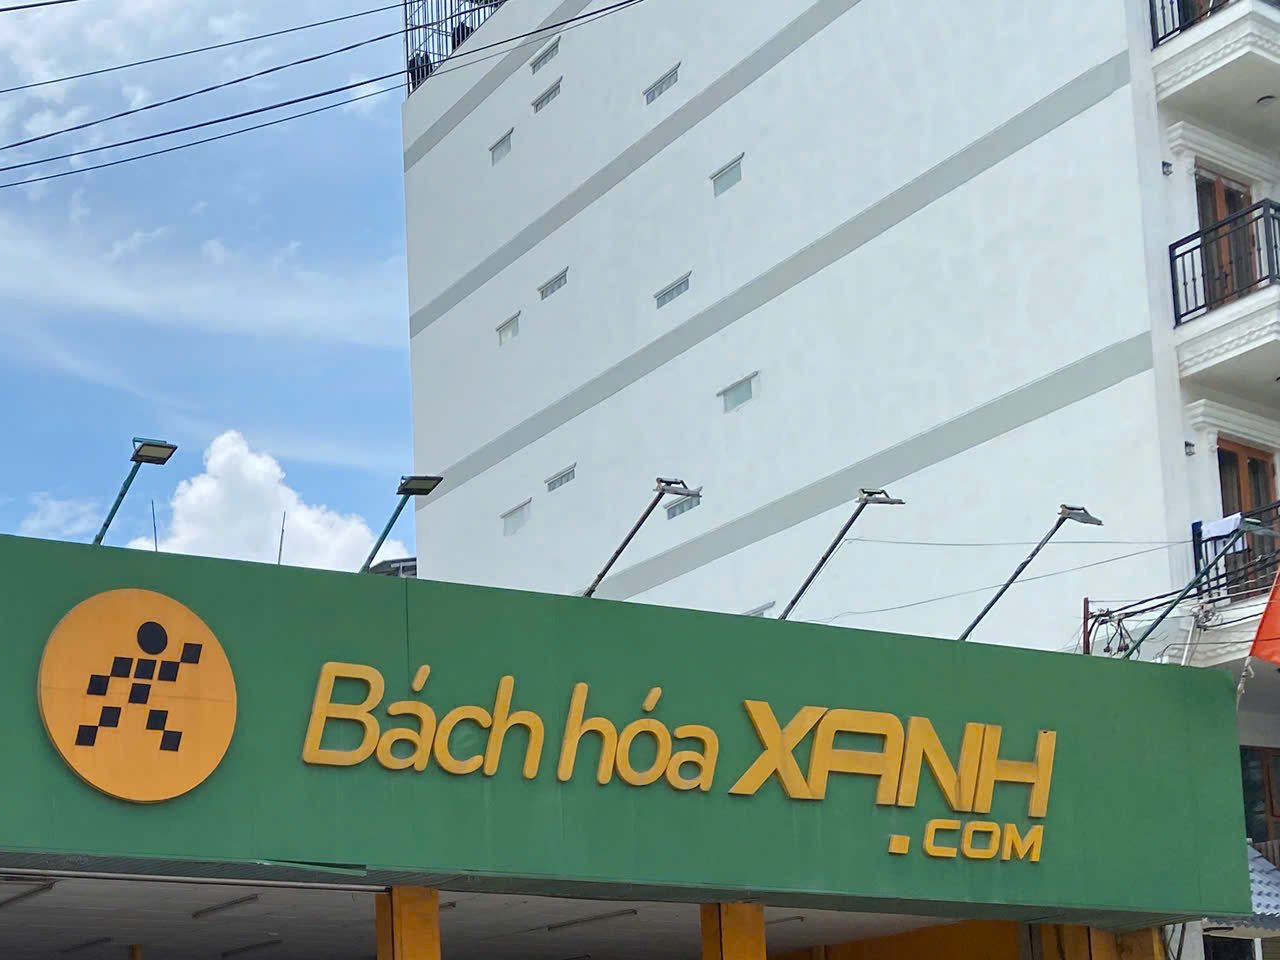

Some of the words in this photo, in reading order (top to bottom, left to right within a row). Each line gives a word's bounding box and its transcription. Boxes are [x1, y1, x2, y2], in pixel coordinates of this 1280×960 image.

[302, 661, 545, 780] Bách
[557, 682, 720, 792] hóa
[728, 700, 1057, 819] XANH
[888, 819, 1044, 862] .COM
